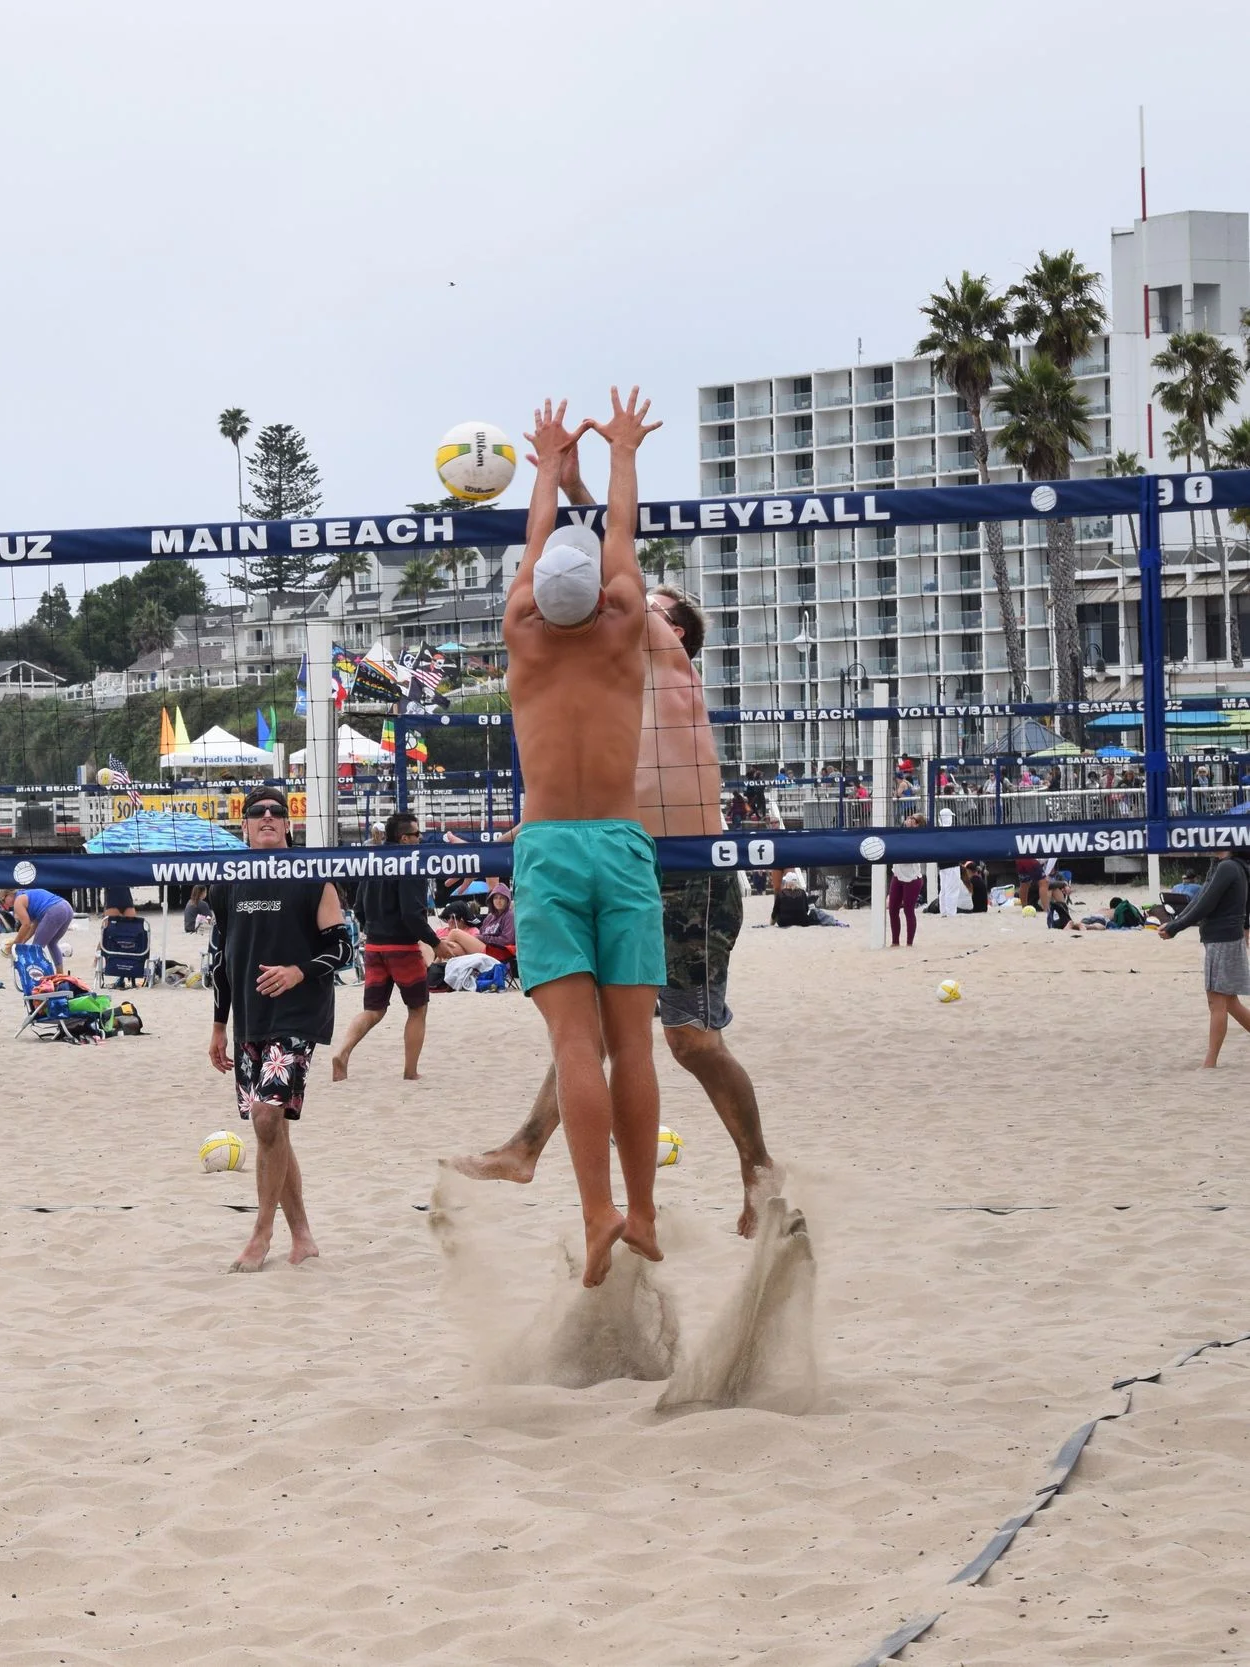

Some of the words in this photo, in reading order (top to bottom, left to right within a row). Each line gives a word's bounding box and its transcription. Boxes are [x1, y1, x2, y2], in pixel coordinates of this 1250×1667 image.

[476, 432, 487, 467] Wilson
[151, 525, 268, 554] MAIN
[291, 517, 454, 548] BEACH
[568, 496, 890, 532] VLLEYBALL
[740, 710, 786, 721] MAIN
[793, 710, 854, 720] BEACH
[897, 705, 1015, 718] VOLLEYBALL
[1078, 702, 1133, 713] SANTA
[1136, 700, 1182, 711] CUZ
[192, 755, 233, 764] Paradise
[235, 755, 258, 764] Dogs
[105, 782, 171, 790] VOLLEYBALL
[206, 780, 237, 788] SANTA
[239, 779, 265, 787] CRUZ
[377, 773, 446, 782] VOEYBALL
[1015, 825, 1250, 855] www.santcruzw
[152, 850, 481, 882] www.santacruzwharf.com
[236, 901, 281, 913] SESSIONS
